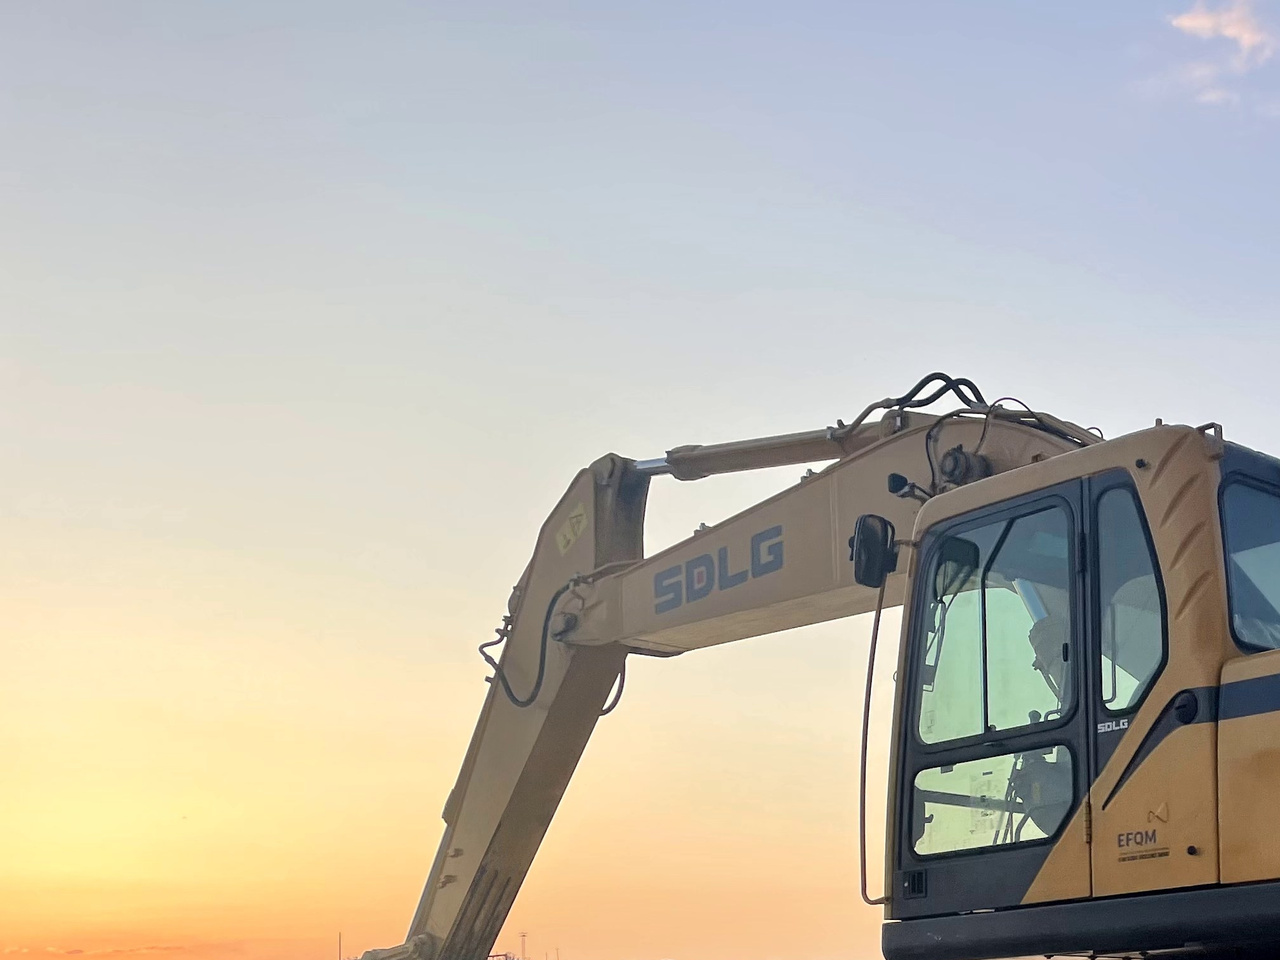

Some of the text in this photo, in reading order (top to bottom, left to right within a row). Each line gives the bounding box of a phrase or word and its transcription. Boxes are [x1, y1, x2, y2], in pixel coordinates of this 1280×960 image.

[654, 525, 784, 615] SDLG
[1097, 719, 1129, 733] SDLG
[1117, 829, 1157, 848] EFQM
